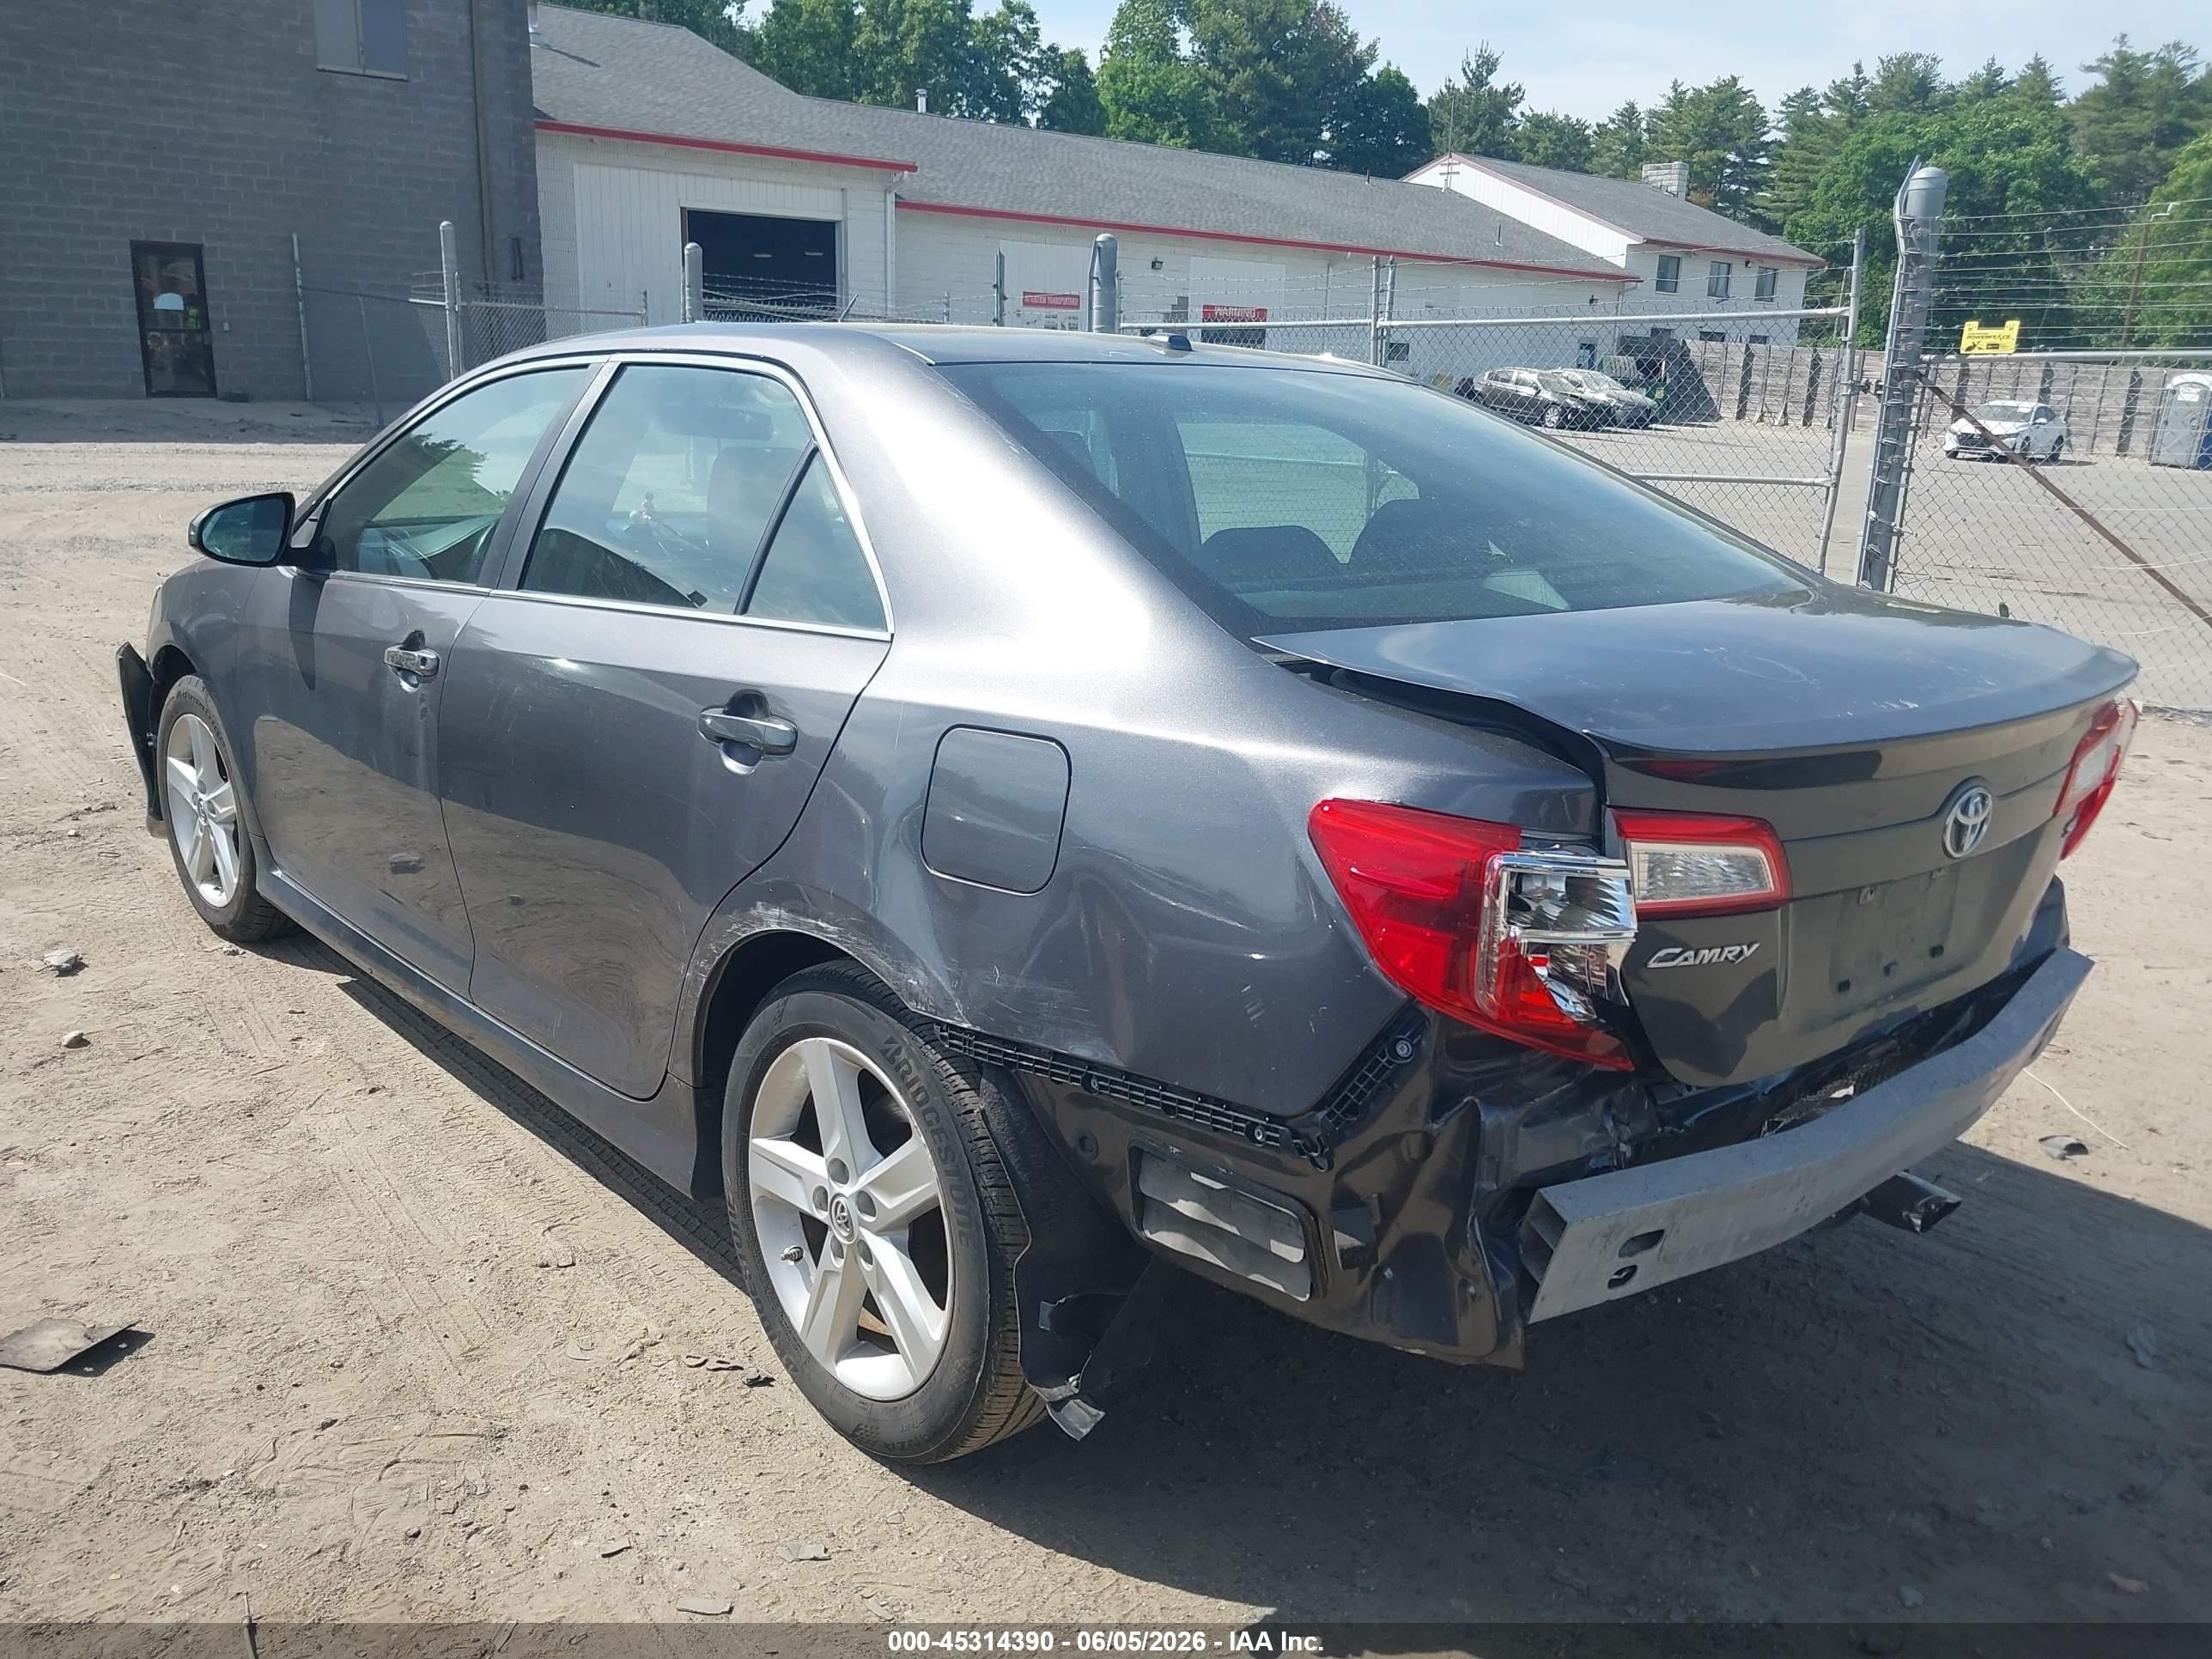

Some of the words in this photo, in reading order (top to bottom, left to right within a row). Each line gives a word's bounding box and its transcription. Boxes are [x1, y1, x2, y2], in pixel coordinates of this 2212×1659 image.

[1215, 307, 1255, 318] WARNING
[1647, 943, 1760, 968] CAMRY
[878, 1036, 974, 1248] BRIDGESTONE
